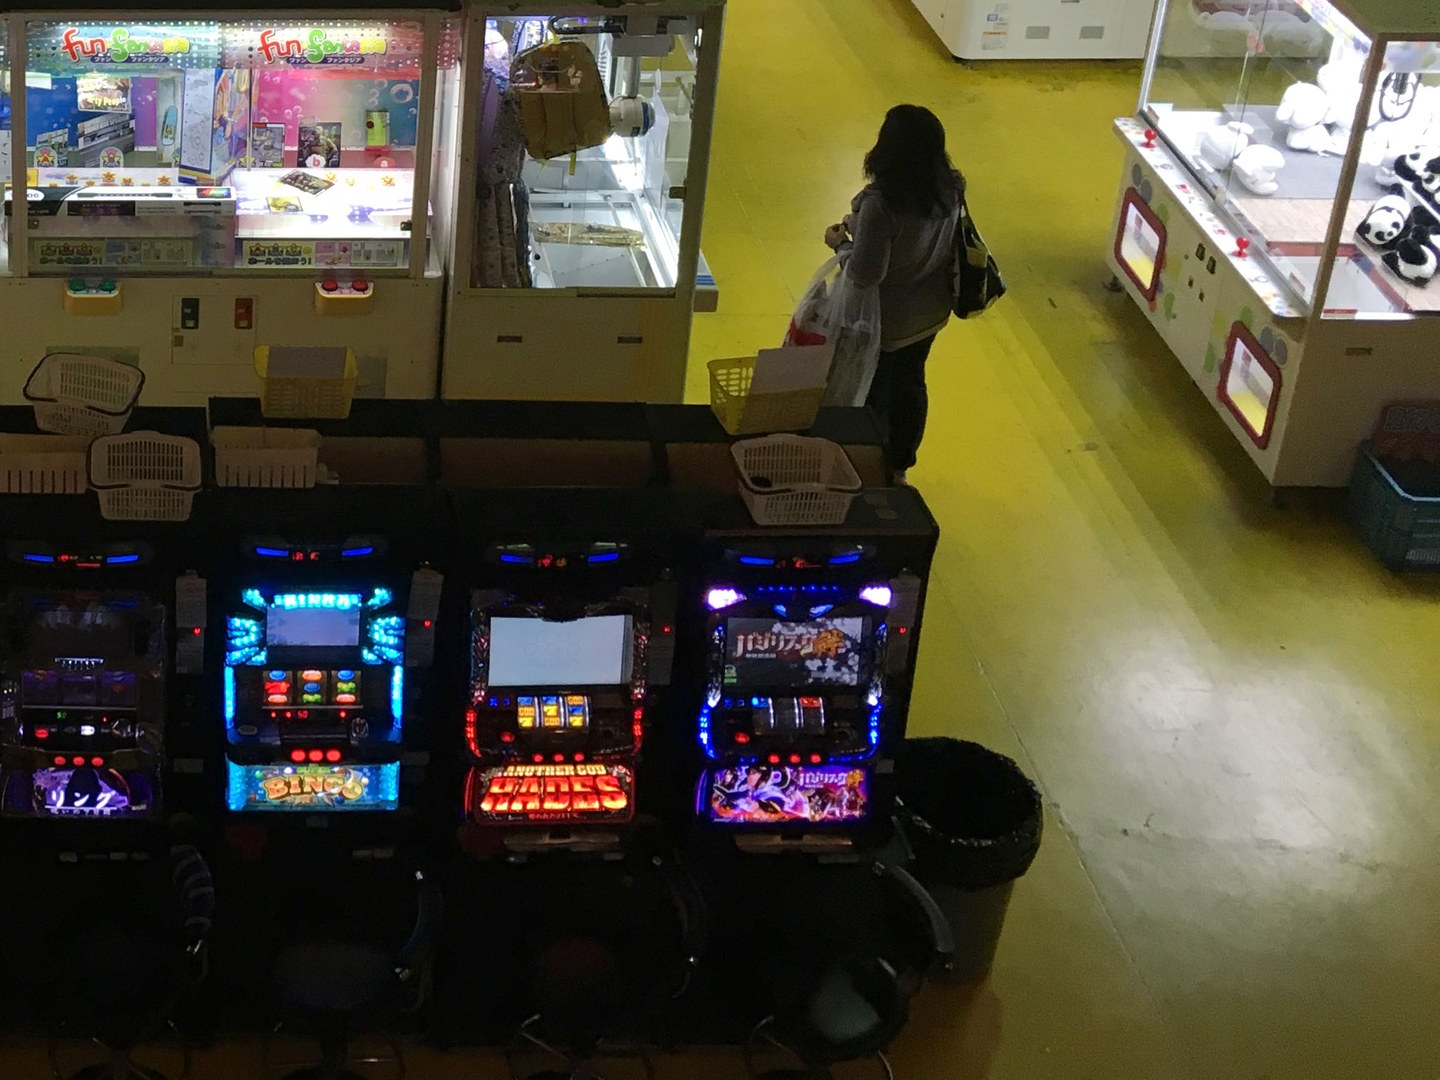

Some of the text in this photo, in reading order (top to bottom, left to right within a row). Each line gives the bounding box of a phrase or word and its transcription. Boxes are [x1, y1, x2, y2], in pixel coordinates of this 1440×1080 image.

[503, 764, 607, 777] ANOTHER GOD
[51, 789, 117, 809] リング
[263, 774, 364, 801] BINGO
[480, 775, 628, 812] HADES
